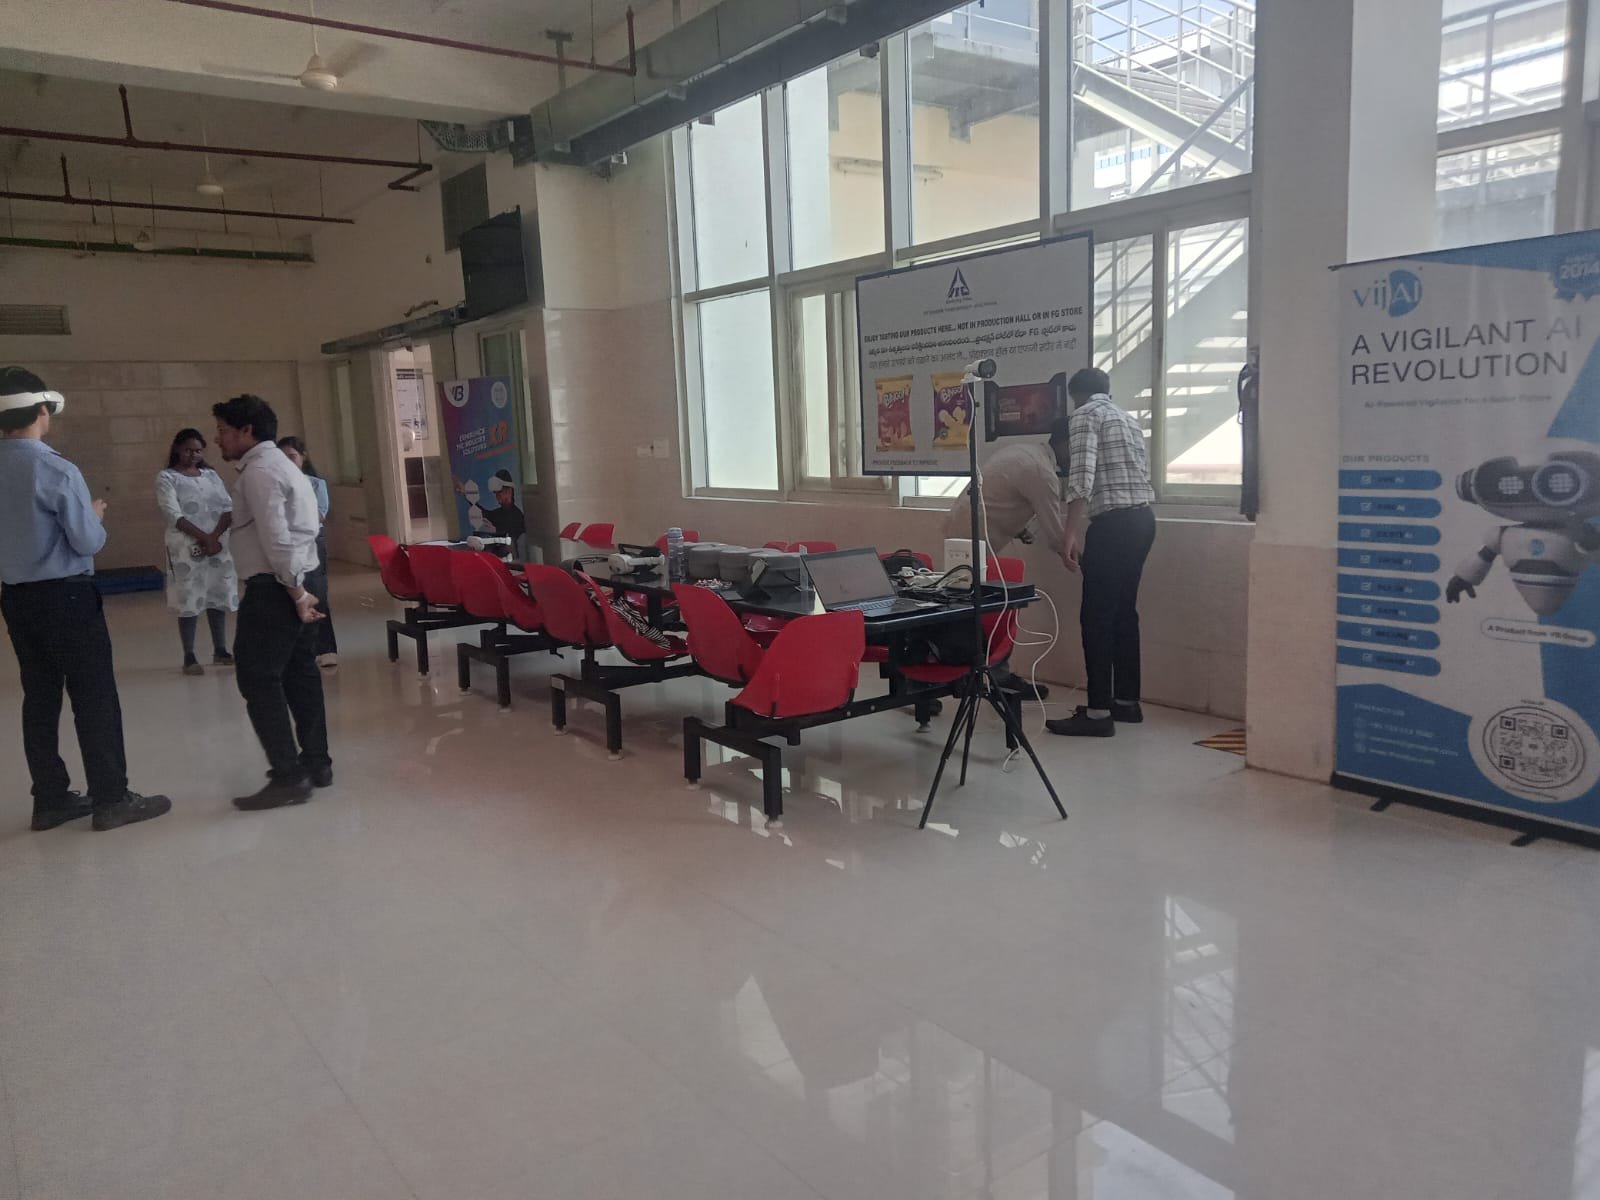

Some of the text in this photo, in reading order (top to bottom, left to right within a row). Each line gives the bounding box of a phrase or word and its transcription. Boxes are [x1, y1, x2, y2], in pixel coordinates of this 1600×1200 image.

[1560, 262, 1599, 279] 2014
[864, 334, 879, 344] ENJOY
[880, 331, 899, 341] TASTING
[900, 330, 910, 338] OUR
[910, 326, 937, 337] PRODUCTS
[958, 322, 970, 330] NOT
[970, 320, 976, 328] IN
[976, 316, 1014, 328] PRODUCTION
[1015, 313, 1032, 323] HALL
[1032, 311, 1042, 320] OR
[1043, 310, 1050, 319] IN
[1051, 308, 1060, 318] FG
[1061, 306, 1083, 317] STORE
[1028, 328, 1040, 337] FG
[1351, 315, 1582, 356] A VIGILANT AI
[1351, 350, 1568, 386] REVOLUTION
[1342, 454, 1430, 463] OUR PRODUCTS
